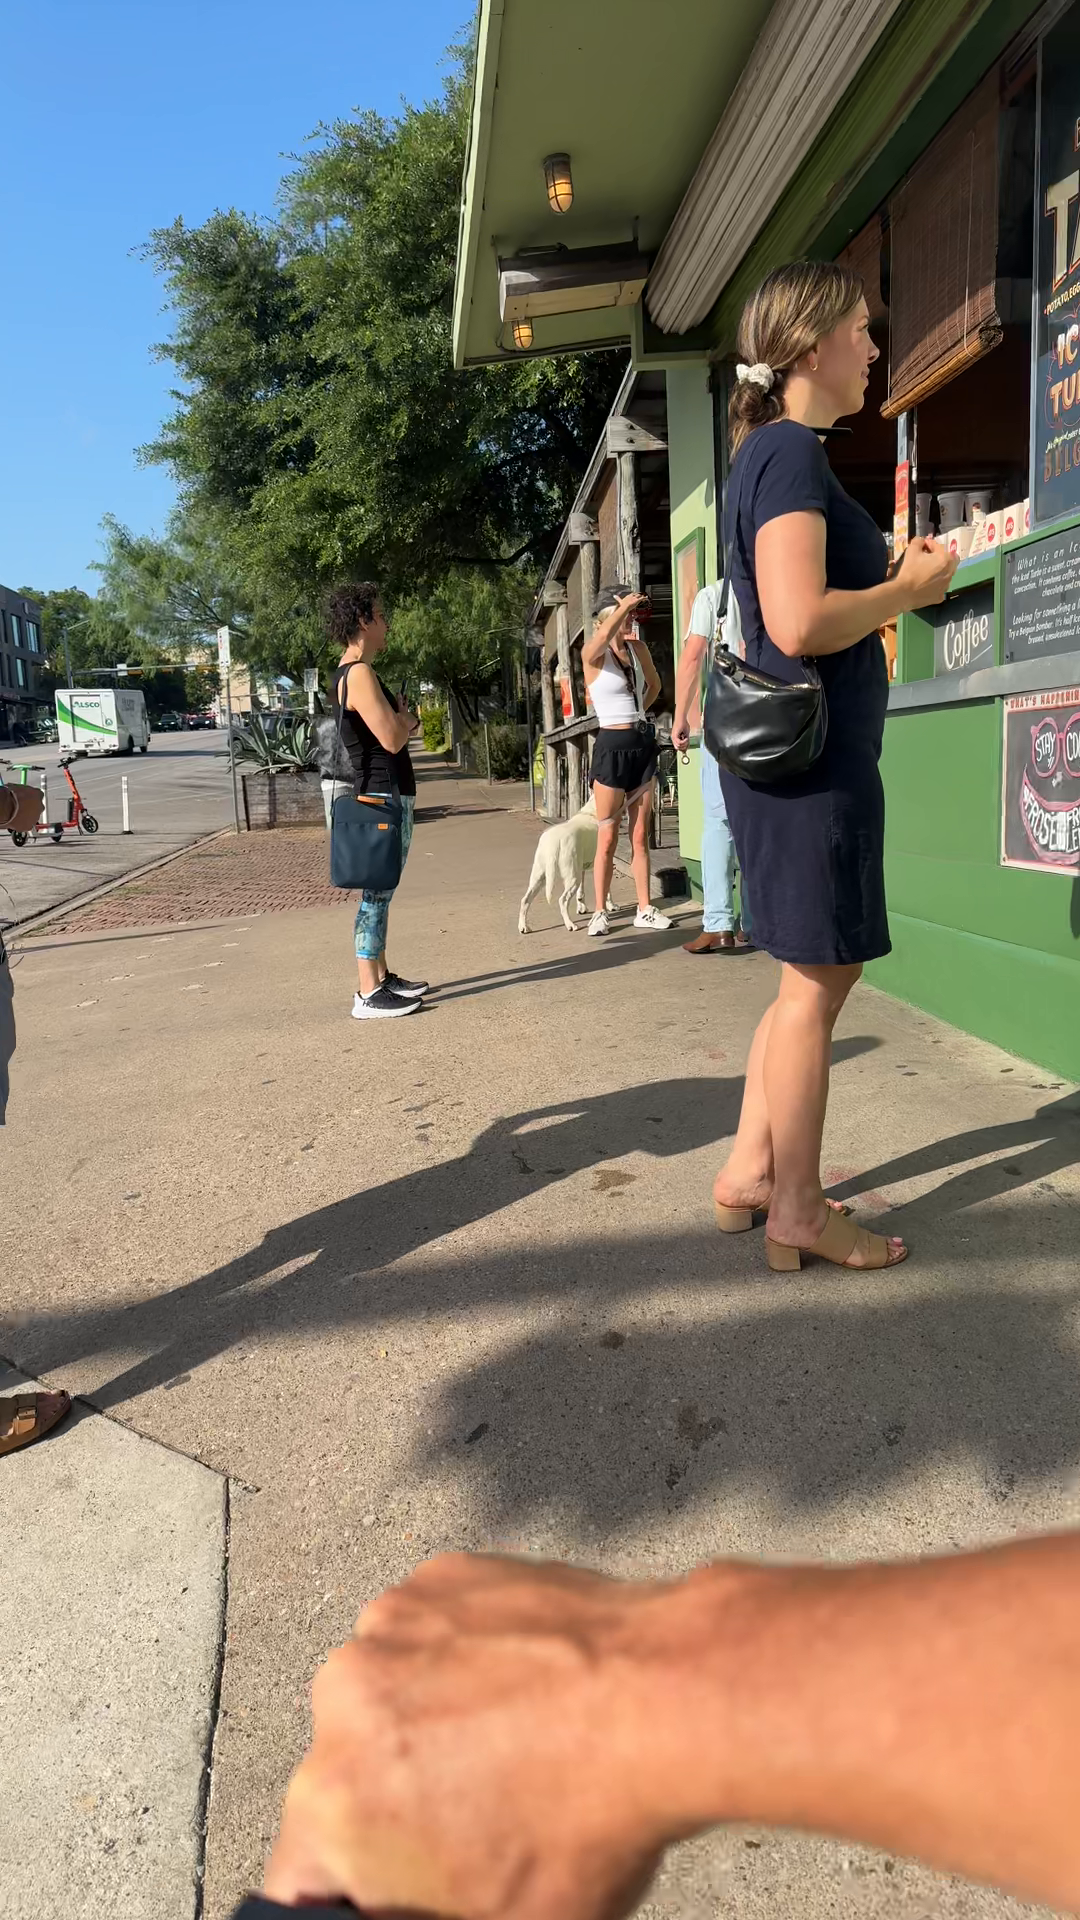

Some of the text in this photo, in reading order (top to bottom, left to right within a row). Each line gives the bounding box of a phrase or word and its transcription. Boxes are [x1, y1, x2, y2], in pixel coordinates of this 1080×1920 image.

[1017, 541, 1080, 571] What is an Ic
[1012, 612, 1033, 626] Looking
[1033, 608, 1042, 624] for
[1042, 602, 1071, 618] something
[944, 609, 989, 671] Coffee
[1008, 629, 1016, 641] Try
[1010, 695, 1037, 709] WHAT'S
[1035, 731, 1080, 762] STAY CO
